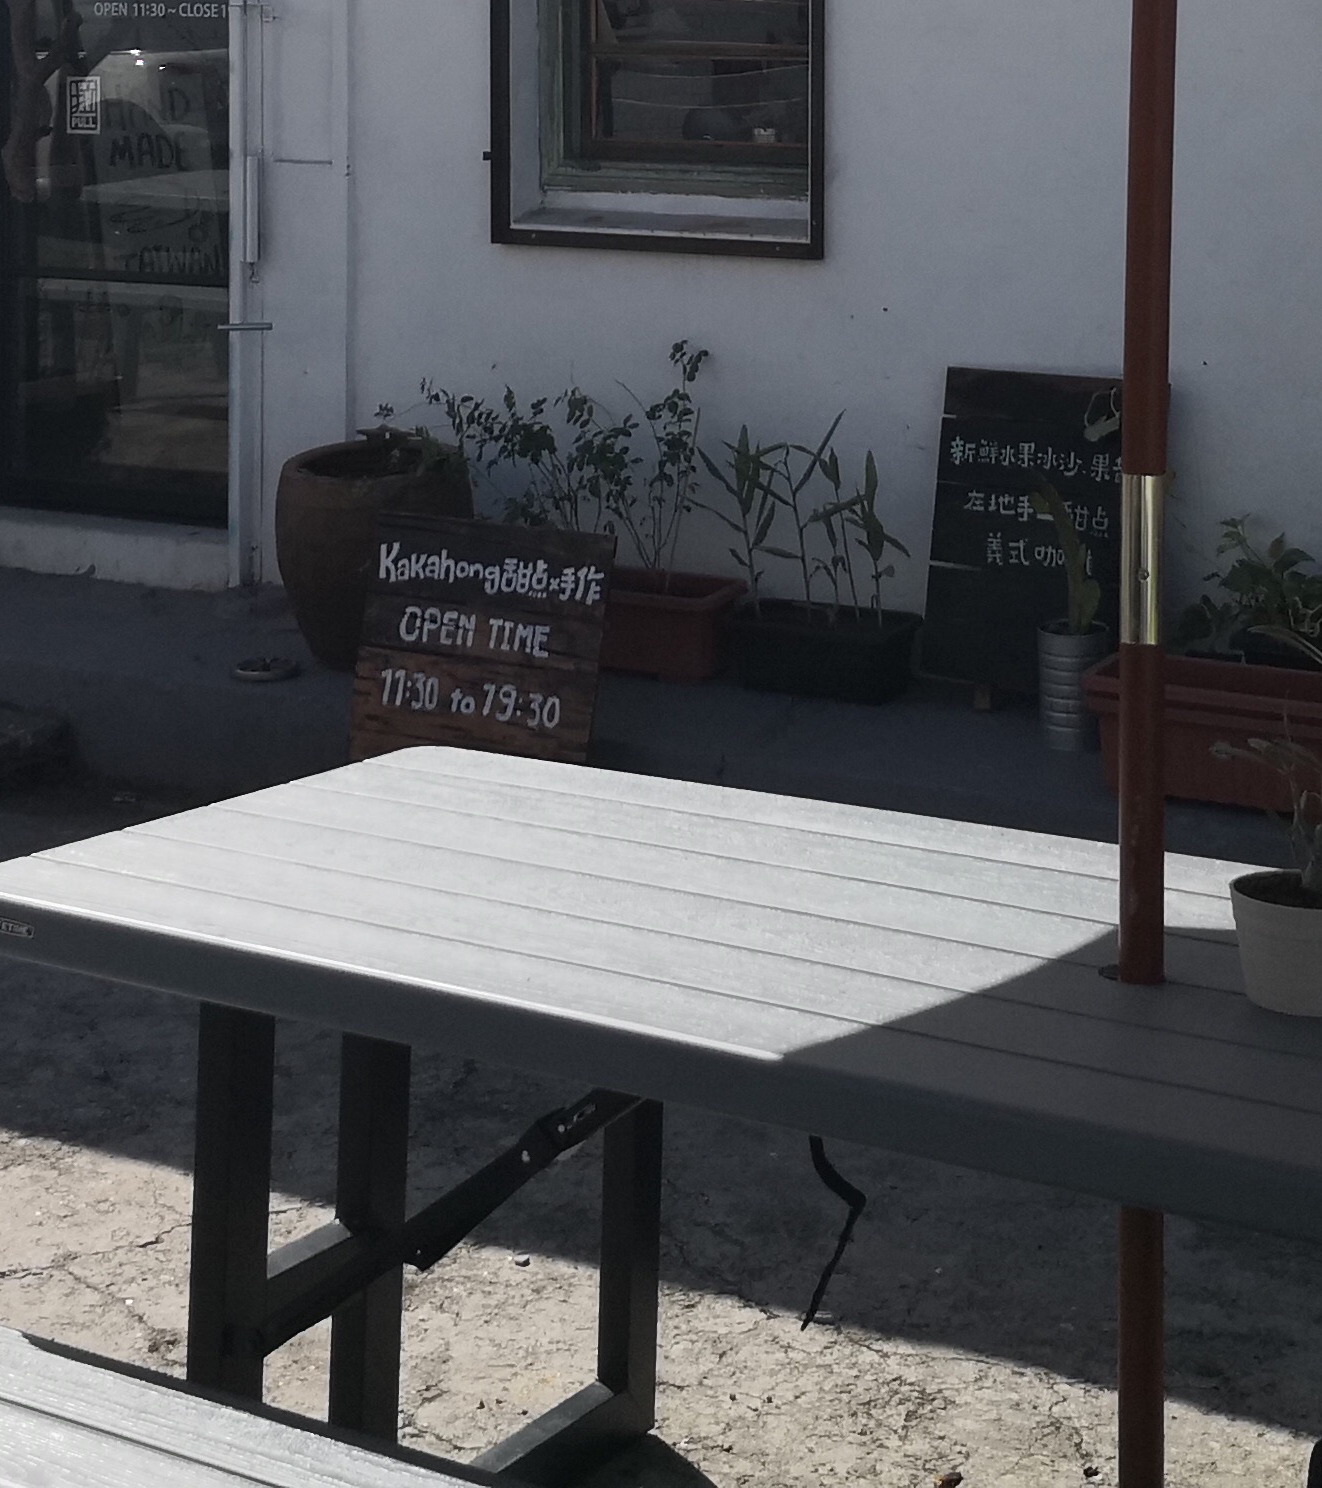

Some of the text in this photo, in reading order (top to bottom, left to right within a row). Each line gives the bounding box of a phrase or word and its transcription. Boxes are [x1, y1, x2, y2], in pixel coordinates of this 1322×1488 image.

[93, 2, 128, 16] OPEN
[132, 2, 166, 16] 11:30
[178, 2, 218, 17] CLOSE
[71, 116, 97, 129] PULL
[109, 132, 188, 171] MADE
[986, 532, 1093, 576] 美式咖
[398, 605, 551, 659] OPEN TIME
[380, 667, 562, 730] 11:30 to 19:30
